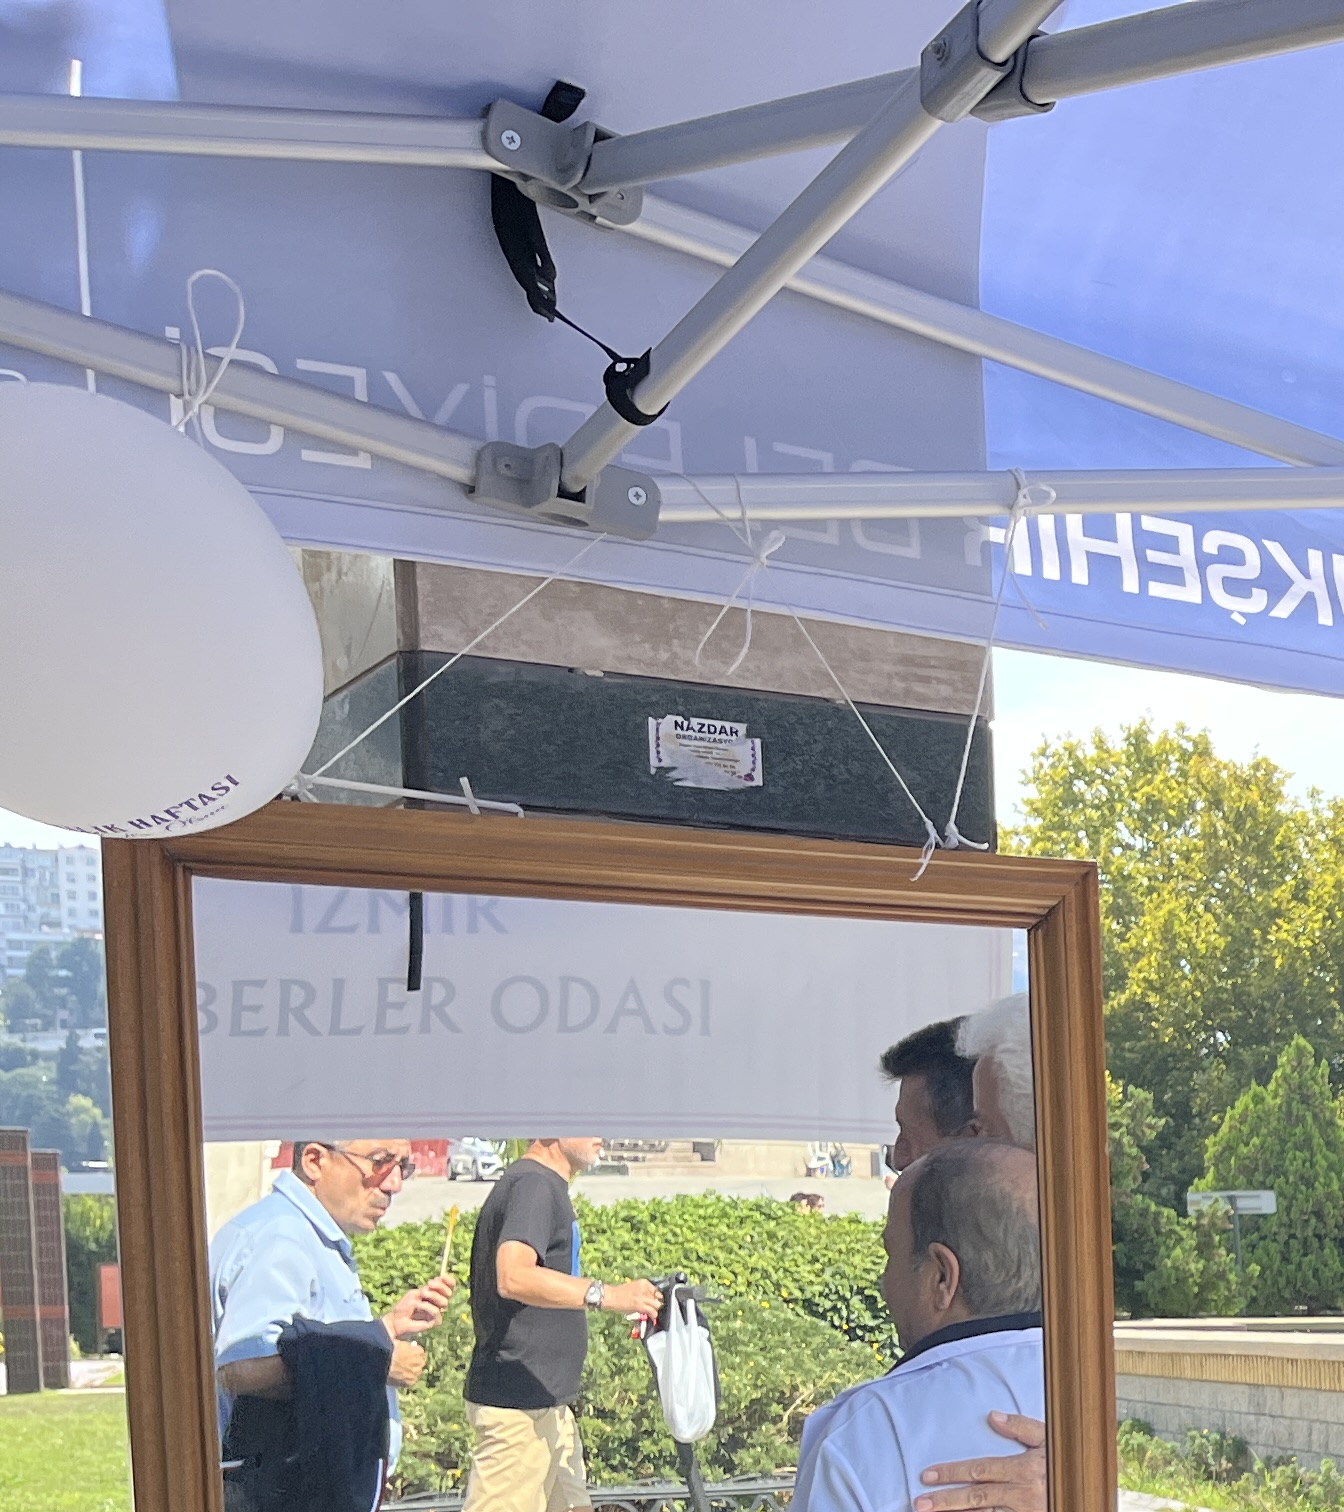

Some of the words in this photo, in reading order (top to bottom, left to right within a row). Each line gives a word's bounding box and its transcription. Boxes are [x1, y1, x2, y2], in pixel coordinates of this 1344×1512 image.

[674, 720, 739, 737] NAZDAR
[128, 774, 239, 830] HAFTASI
[491, 974, 712, 1037] ODASI
